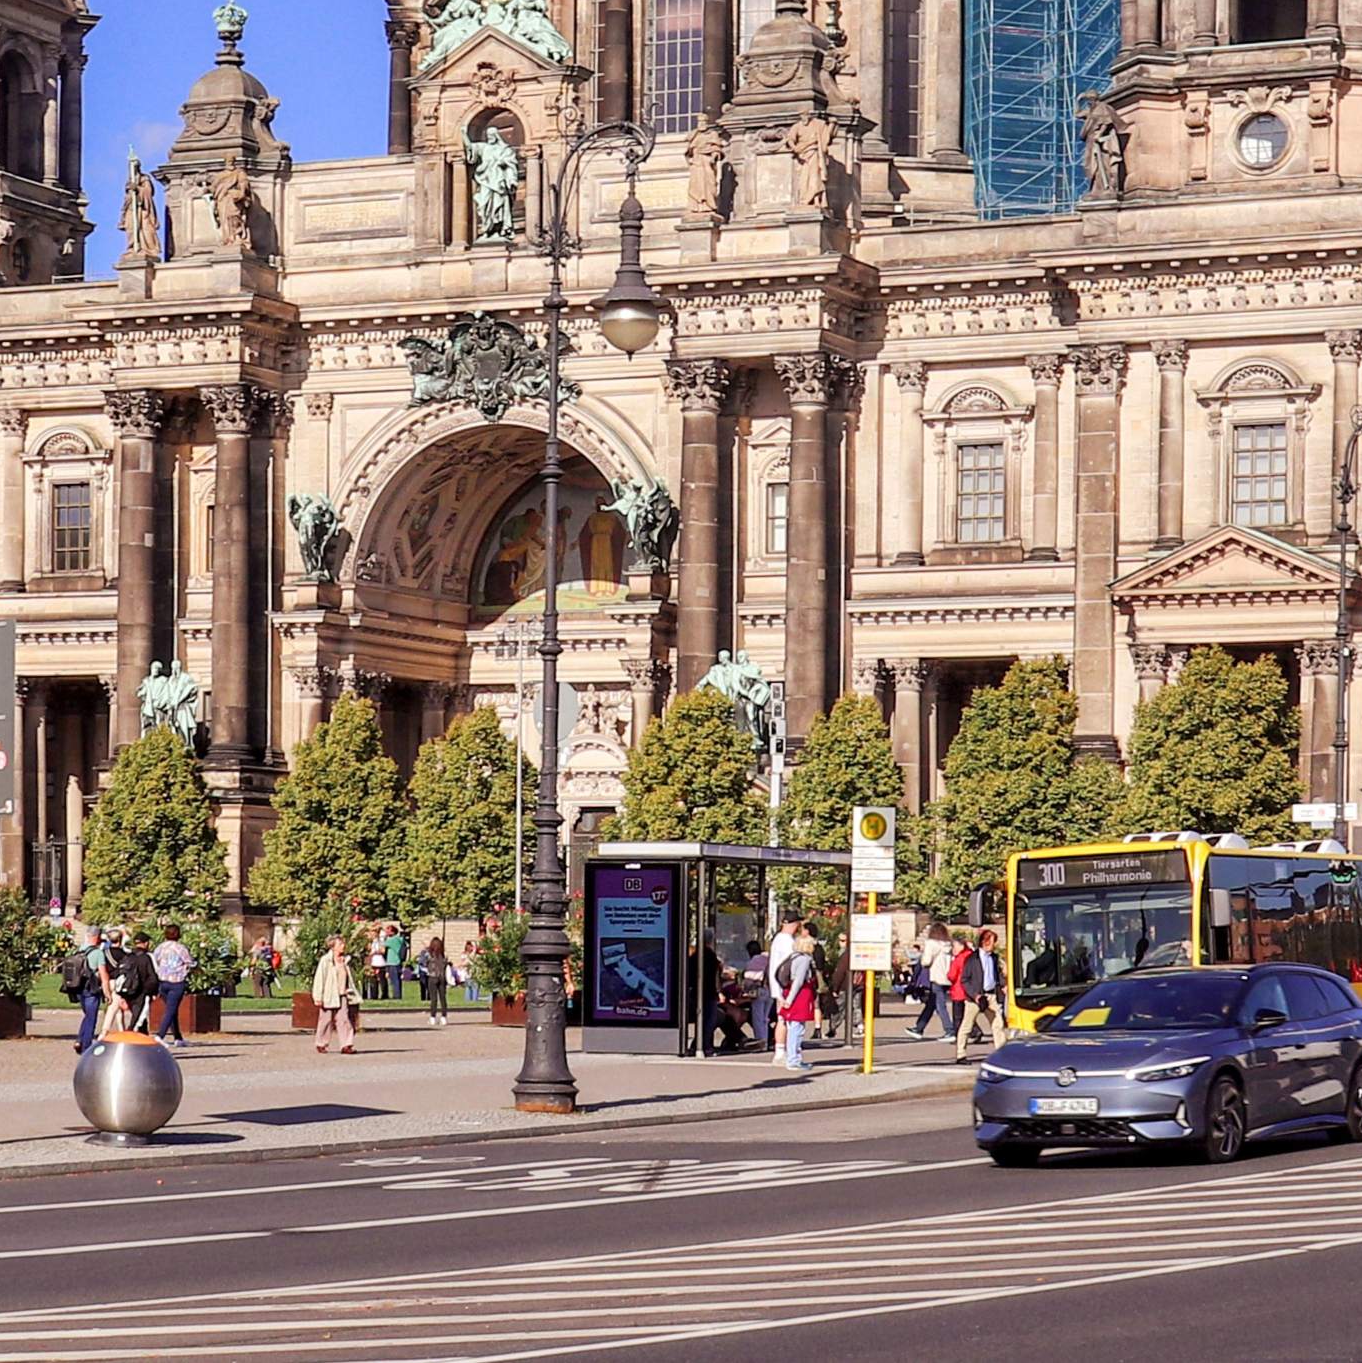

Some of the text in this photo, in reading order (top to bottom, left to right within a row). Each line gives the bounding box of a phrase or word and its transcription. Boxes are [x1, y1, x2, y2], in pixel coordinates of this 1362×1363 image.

[1092, 859, 1141, 869] Tiergarten
[1038, 863, 1065, 886] 300
[1082, 869, 1152, 884] Philharmonie
[625, 879, 641, 890] DB
[616, 1006, 648, 1016] bahn.de
